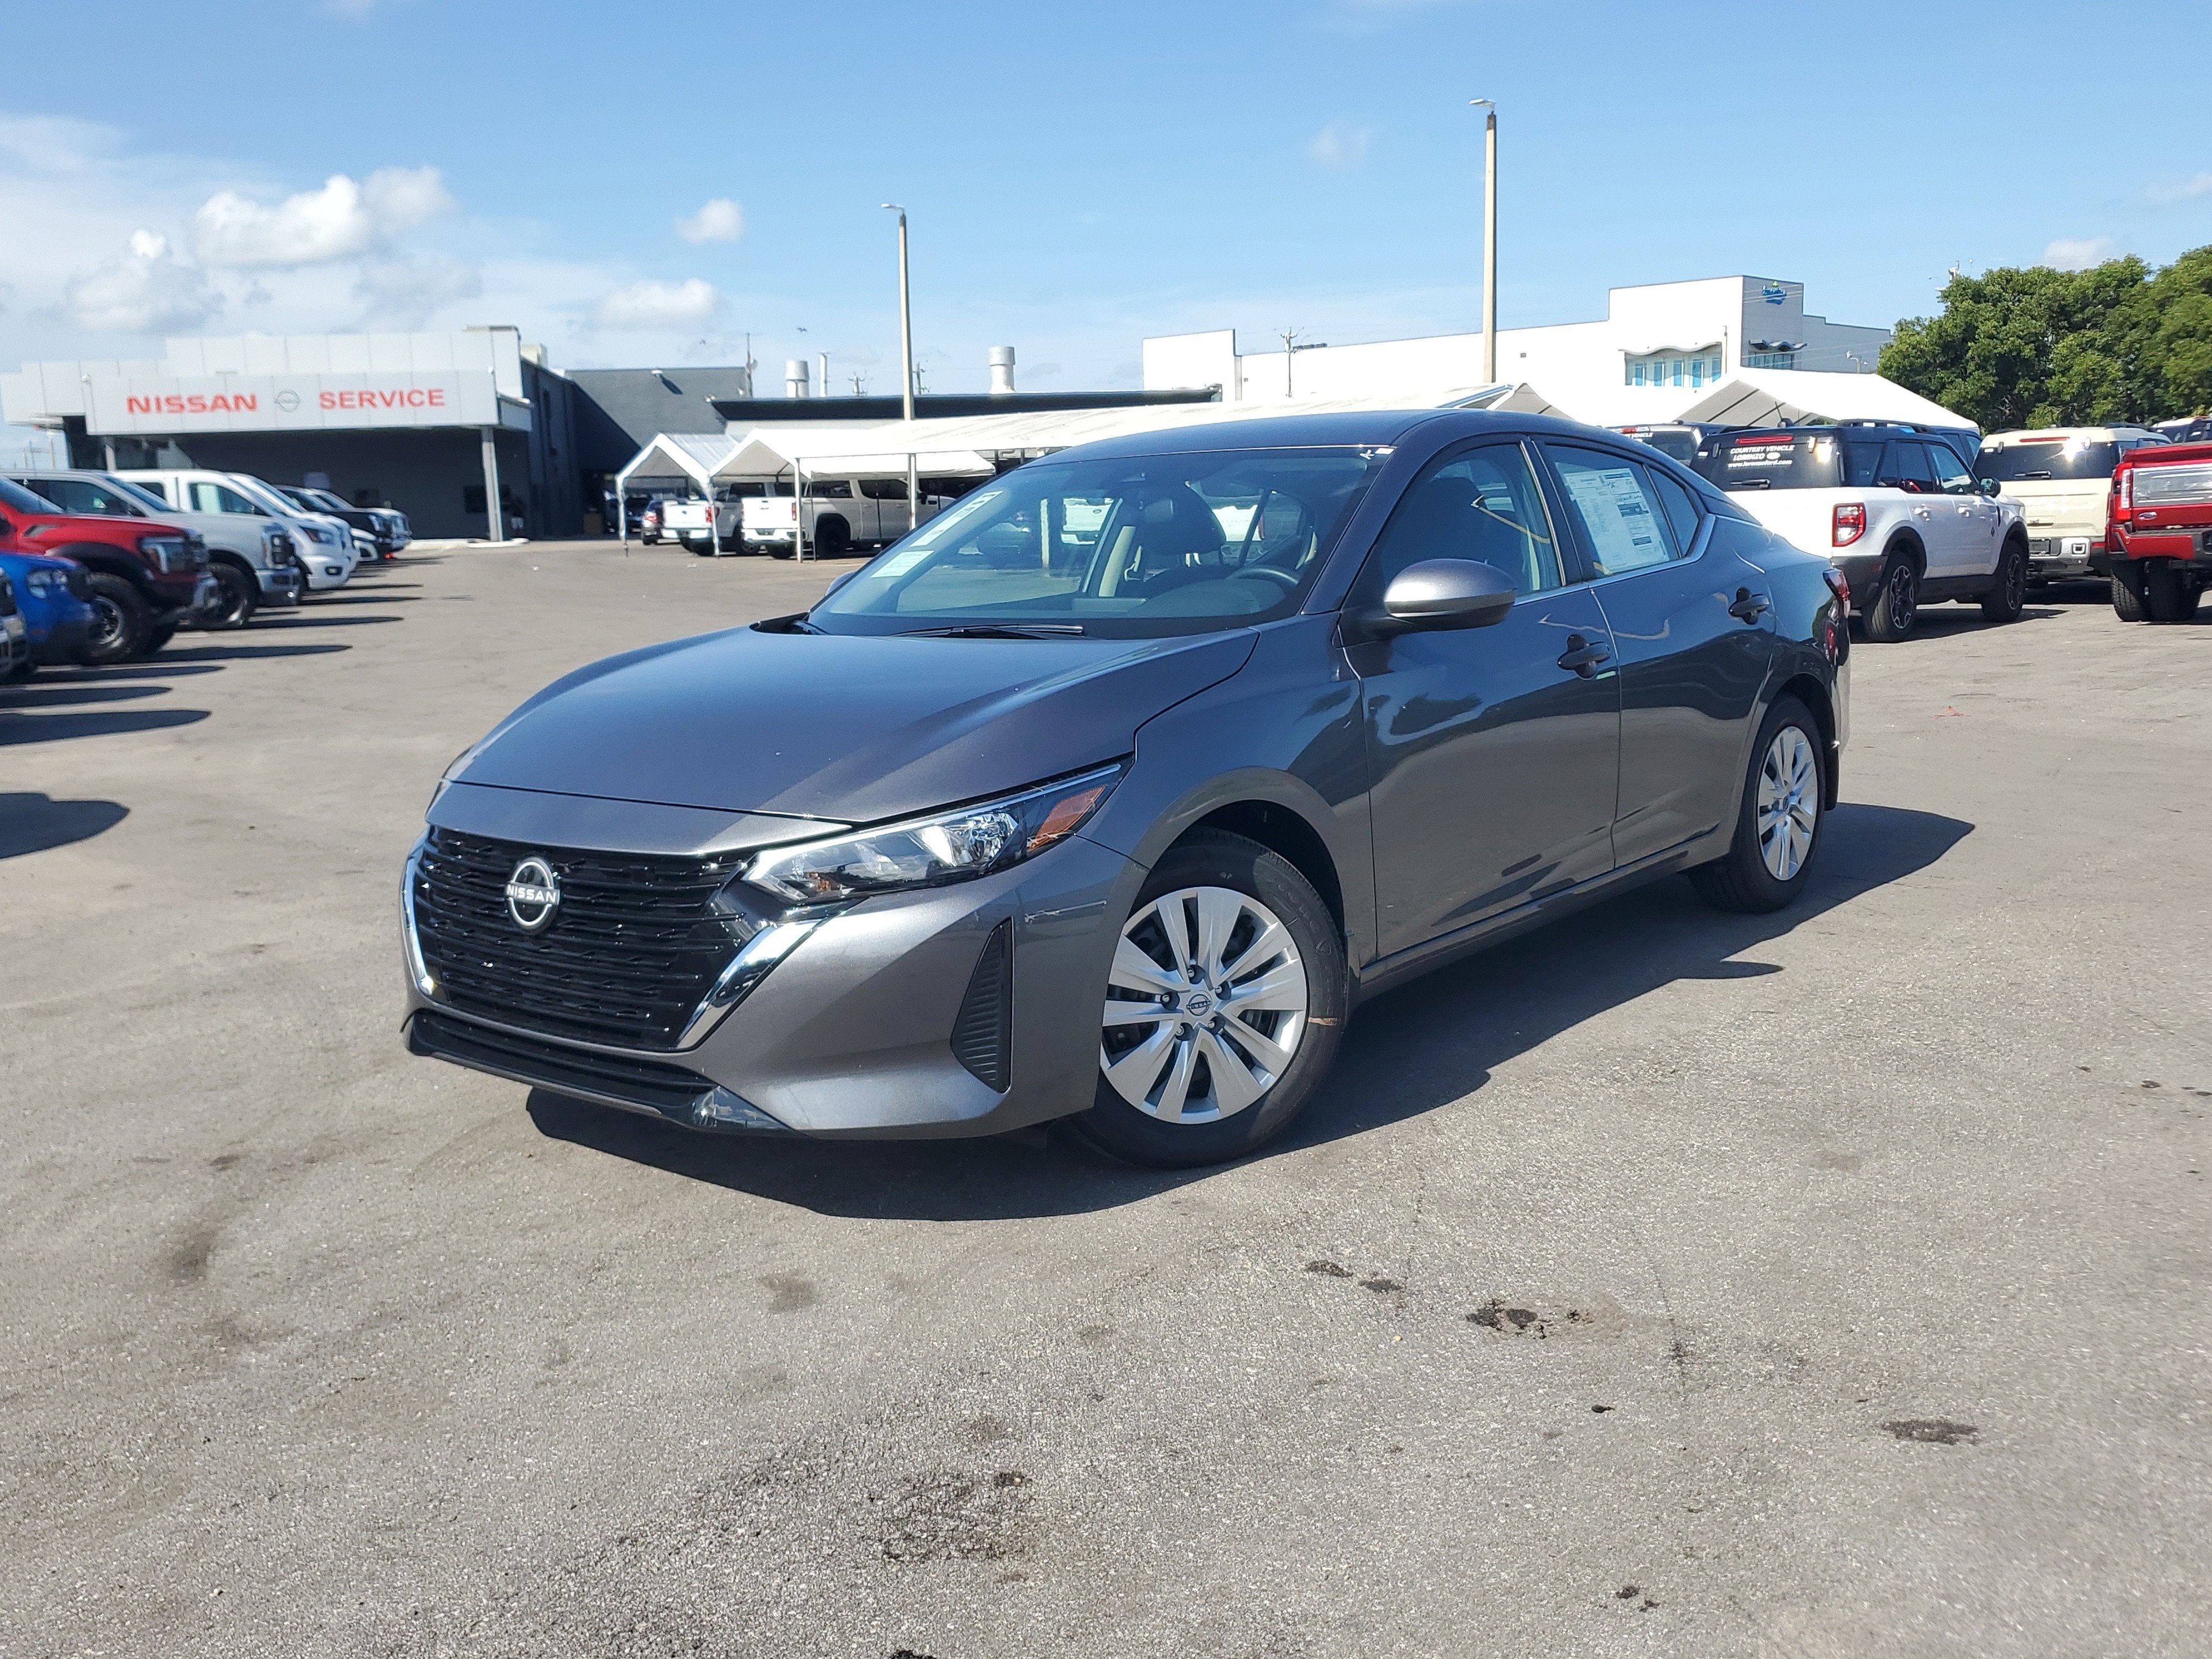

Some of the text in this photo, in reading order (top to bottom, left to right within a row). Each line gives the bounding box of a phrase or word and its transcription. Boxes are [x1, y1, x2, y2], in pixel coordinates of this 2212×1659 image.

[127, 388, 445, 414] NISSAN SERVICE
[1730, 446, 1765, 454] COURTESY
[506, 884, 556, 903] NISSAN
[1186, 1000, 1212, 1009] NISSAN
